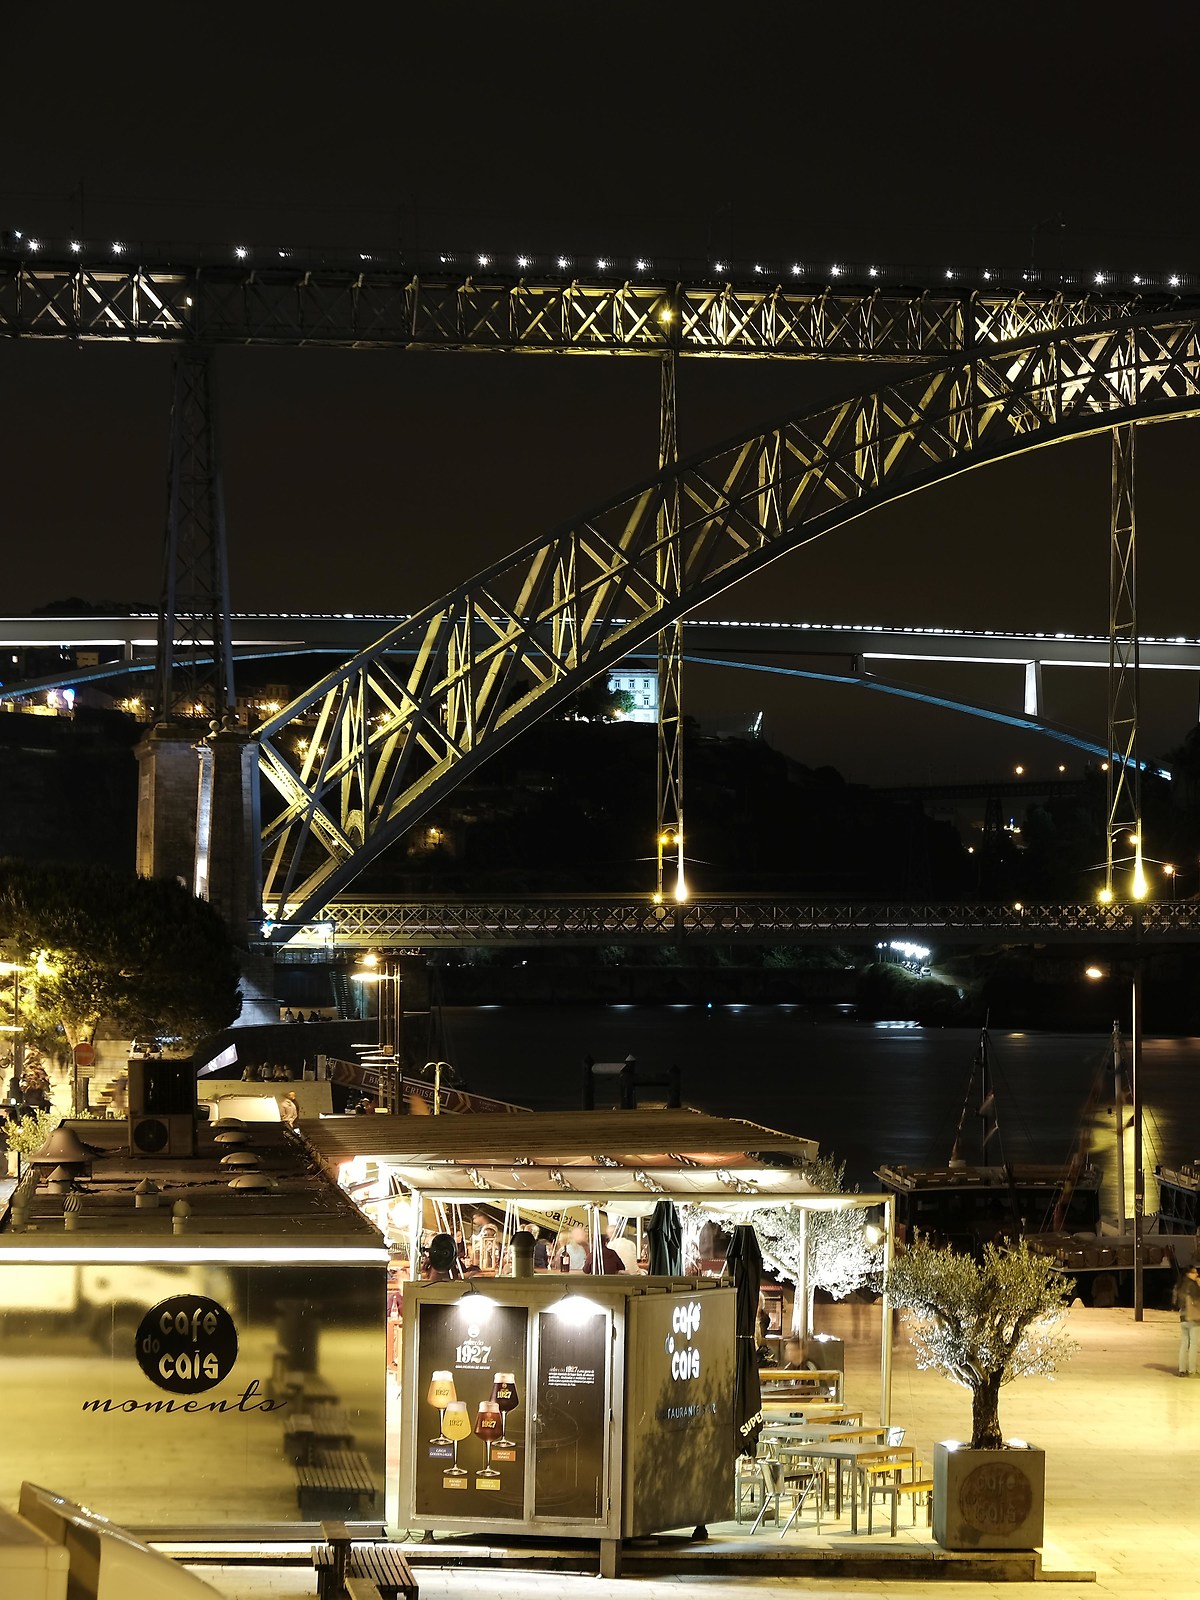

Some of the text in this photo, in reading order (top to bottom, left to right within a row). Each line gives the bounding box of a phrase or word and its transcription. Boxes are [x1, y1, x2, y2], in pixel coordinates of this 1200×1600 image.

[405, 1085, 443, 1103] CRUISE
[142, 1334, 161, 1354] do
[455, 1345, 491, 1363] 1927
[158, 1349, 219, 1380] cais
[672, 1347, 700, 1381] cais
[82, 1379, 288, 1413] moments
